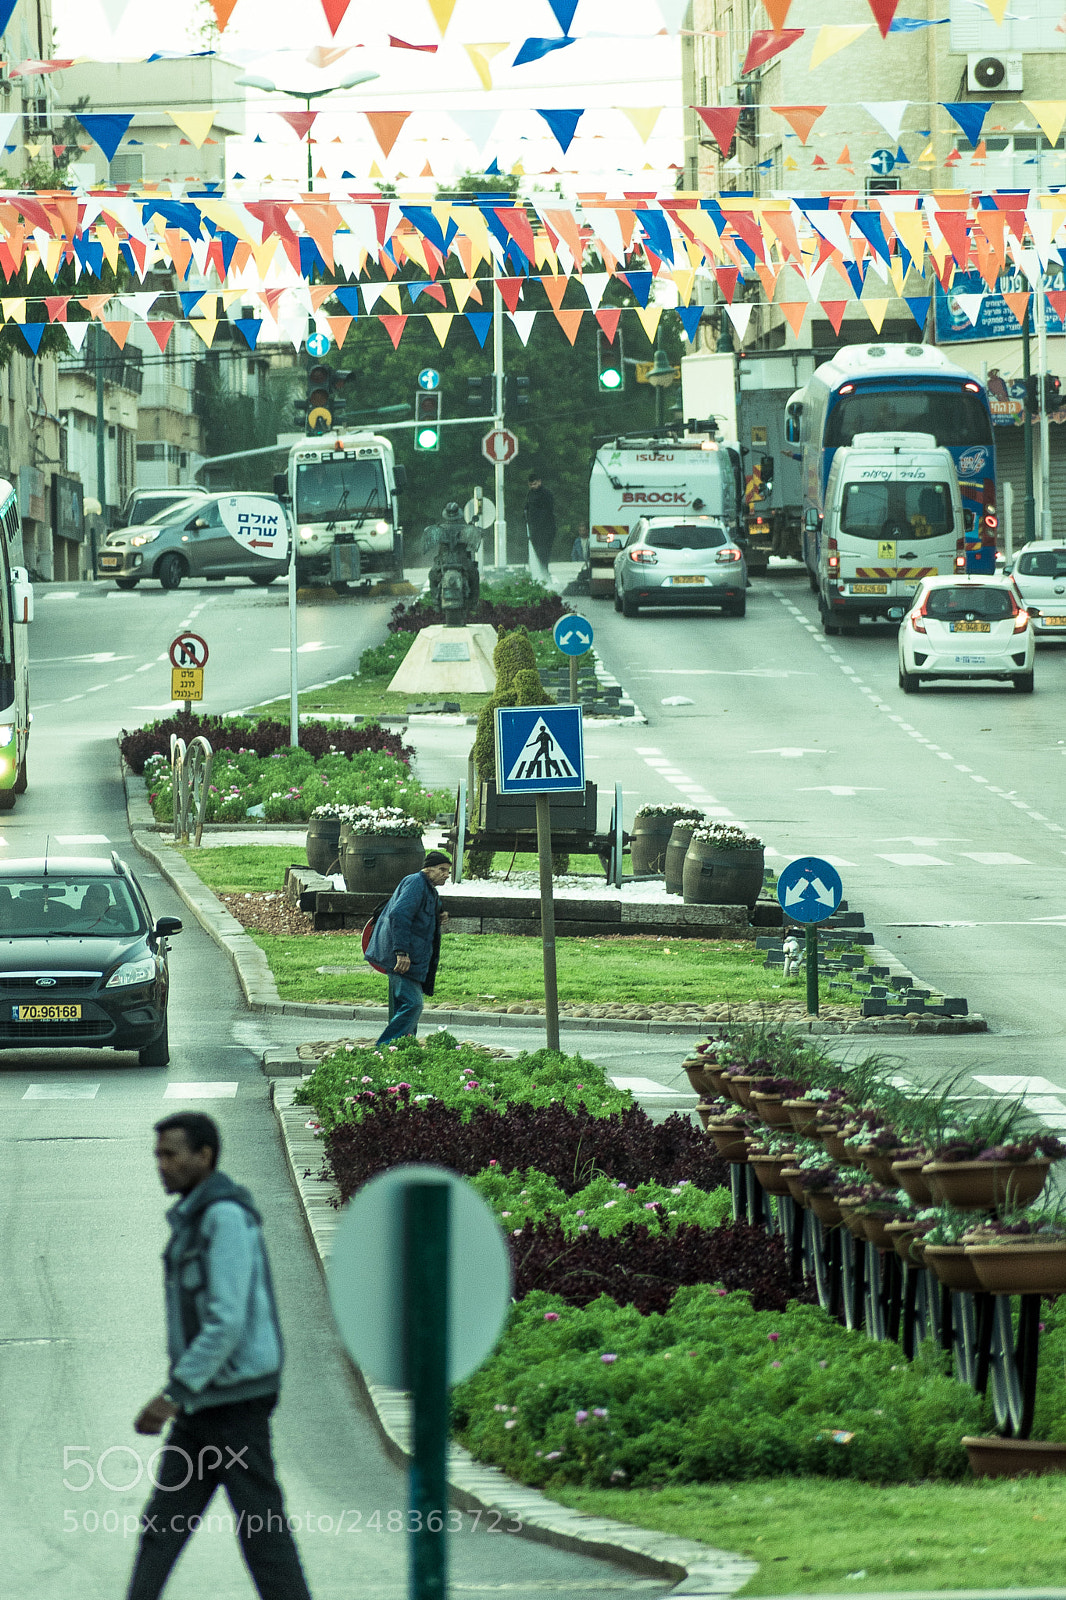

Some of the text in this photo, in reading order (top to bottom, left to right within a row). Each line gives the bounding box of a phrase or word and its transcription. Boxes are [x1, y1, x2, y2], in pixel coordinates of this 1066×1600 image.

[636, 454, 675, 462] ISUZU
[622, 492, 686, 503] BROCK
[237, 513, 278, 525] אולם
[237, 526, 278, 537] שרת
[180, 680, 195, 688] לרכב
